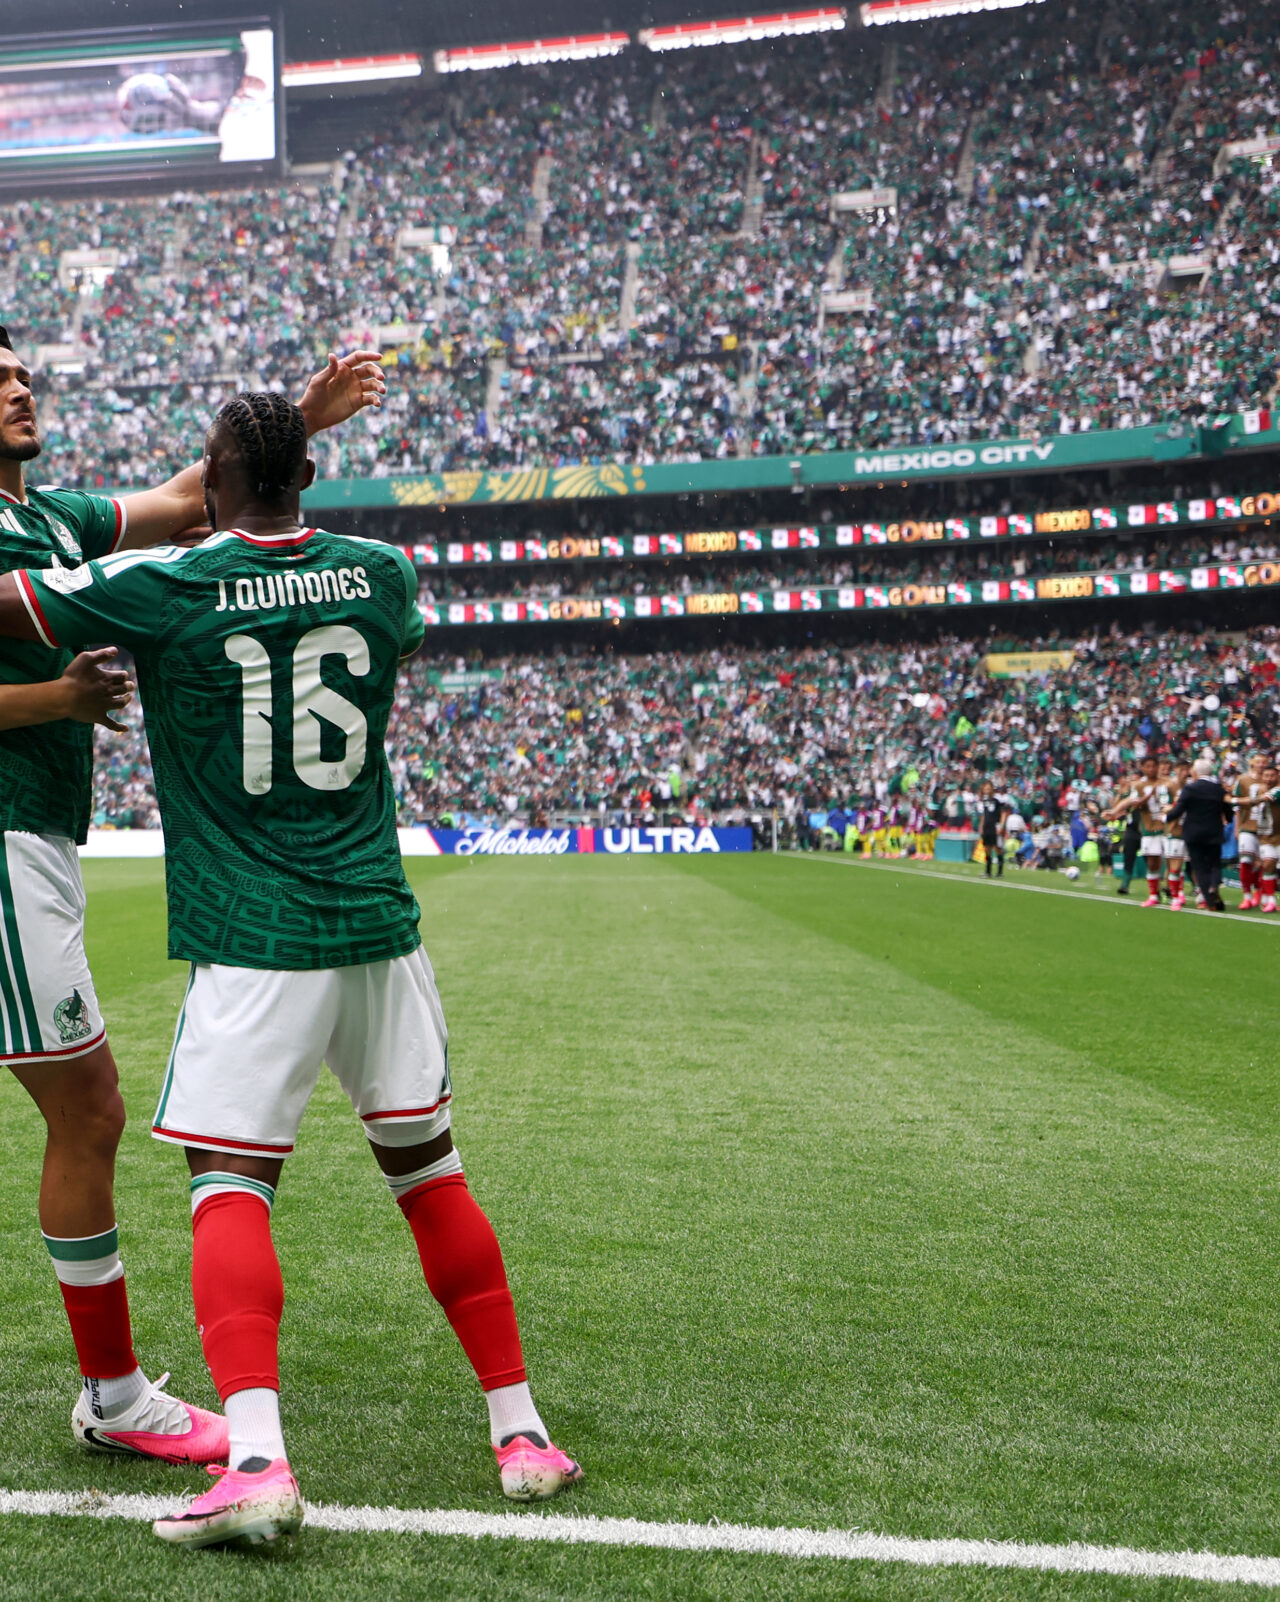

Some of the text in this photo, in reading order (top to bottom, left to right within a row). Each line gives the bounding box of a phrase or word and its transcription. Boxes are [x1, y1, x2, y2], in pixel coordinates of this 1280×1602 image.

[855, 442, 1055, 474] MEXICO CITY
[684, 531, 737, 552] MEXICO
[215, 566, 371, 612] J.QUIÑONES
[686, 593, 738, 614] MEXICO
[224, 625, 370, 796] 16
[455, 827, 721, 855] Michelob ULTRA
